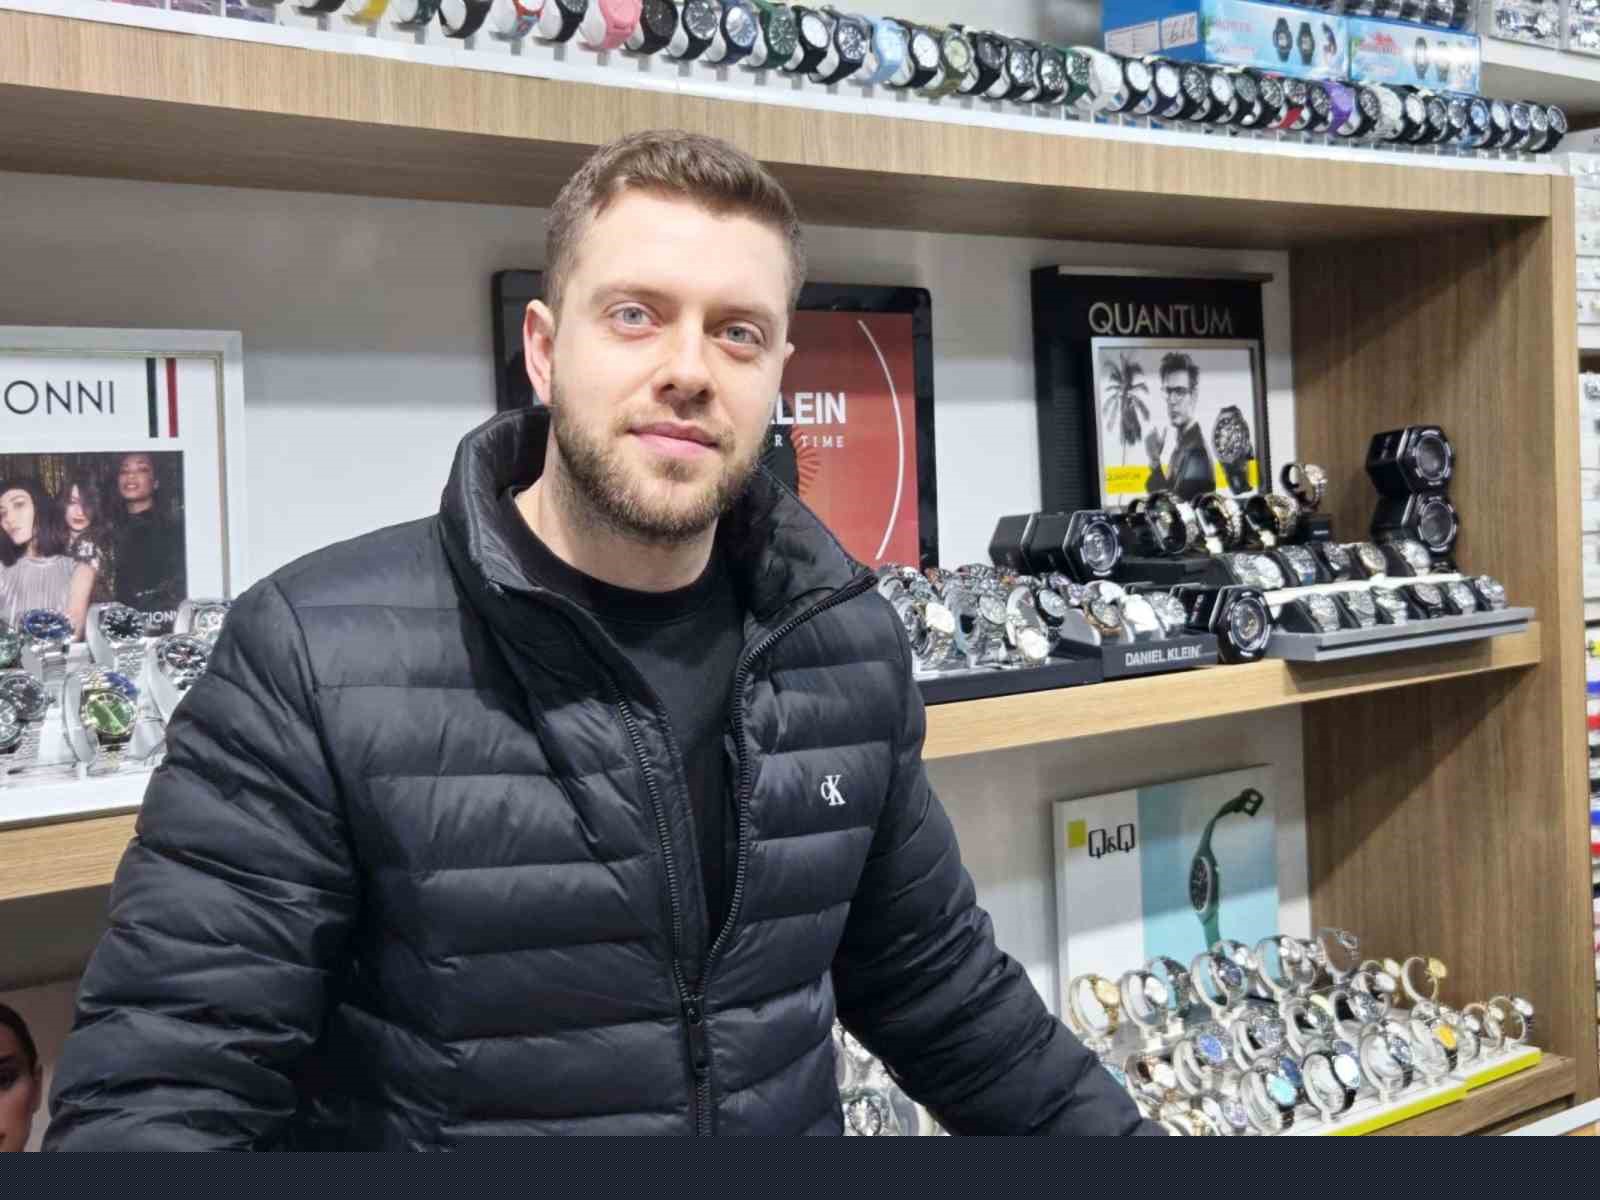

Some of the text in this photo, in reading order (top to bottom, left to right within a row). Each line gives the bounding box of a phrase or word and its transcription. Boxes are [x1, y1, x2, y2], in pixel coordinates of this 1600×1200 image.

[1088, 302, 1233, 335] QUANTUM
[4, 380, 114, 415] ONNI
[771, 392, 846, 424] LEIN
[801, 434, 844, 448] TIME
[1125, 645, 1201, 666] DANIEL KLEIN
[1088, 823, 1135, 859] Q&Q
